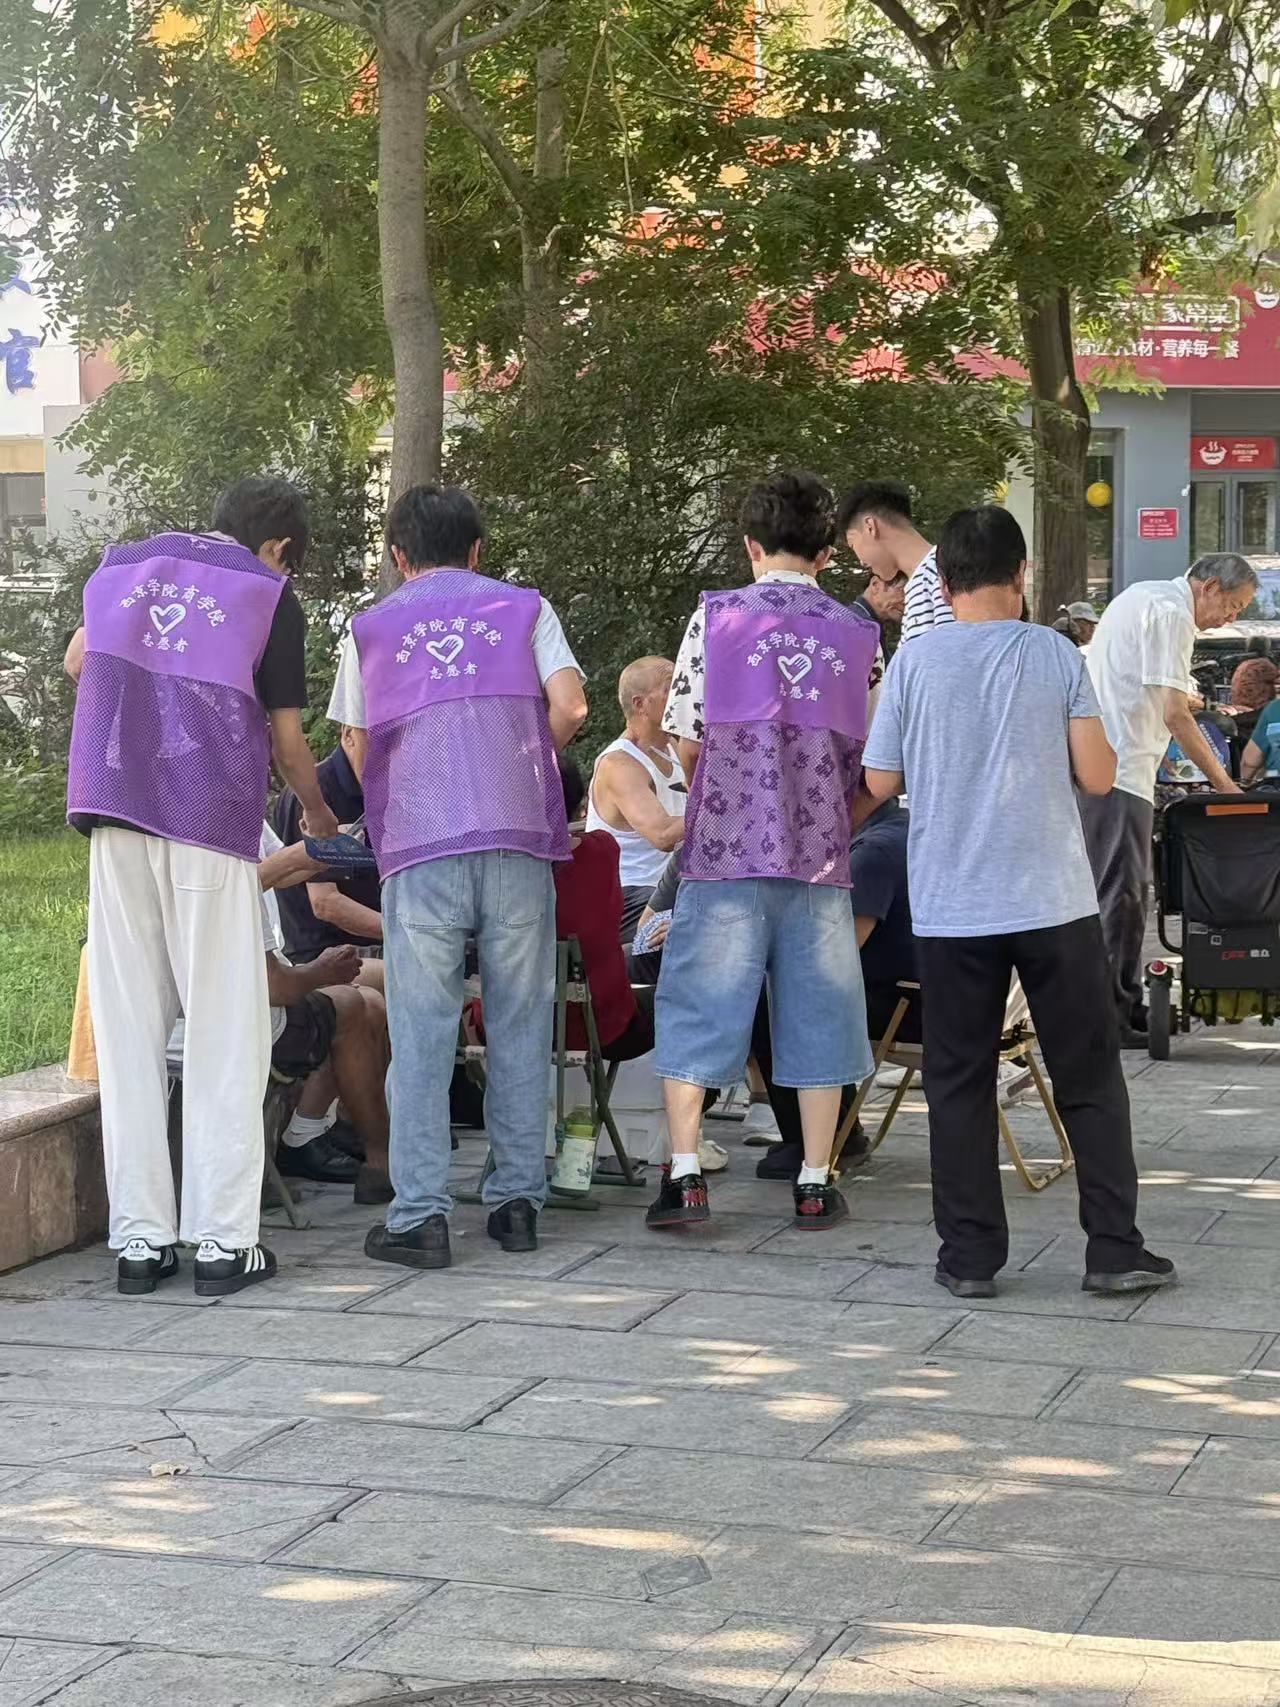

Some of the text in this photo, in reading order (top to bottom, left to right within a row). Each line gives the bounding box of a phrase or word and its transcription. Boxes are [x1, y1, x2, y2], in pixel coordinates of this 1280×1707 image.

[141, 631, 189, 653] 志愿者
[428, 661, 478, 680] 志愿者
